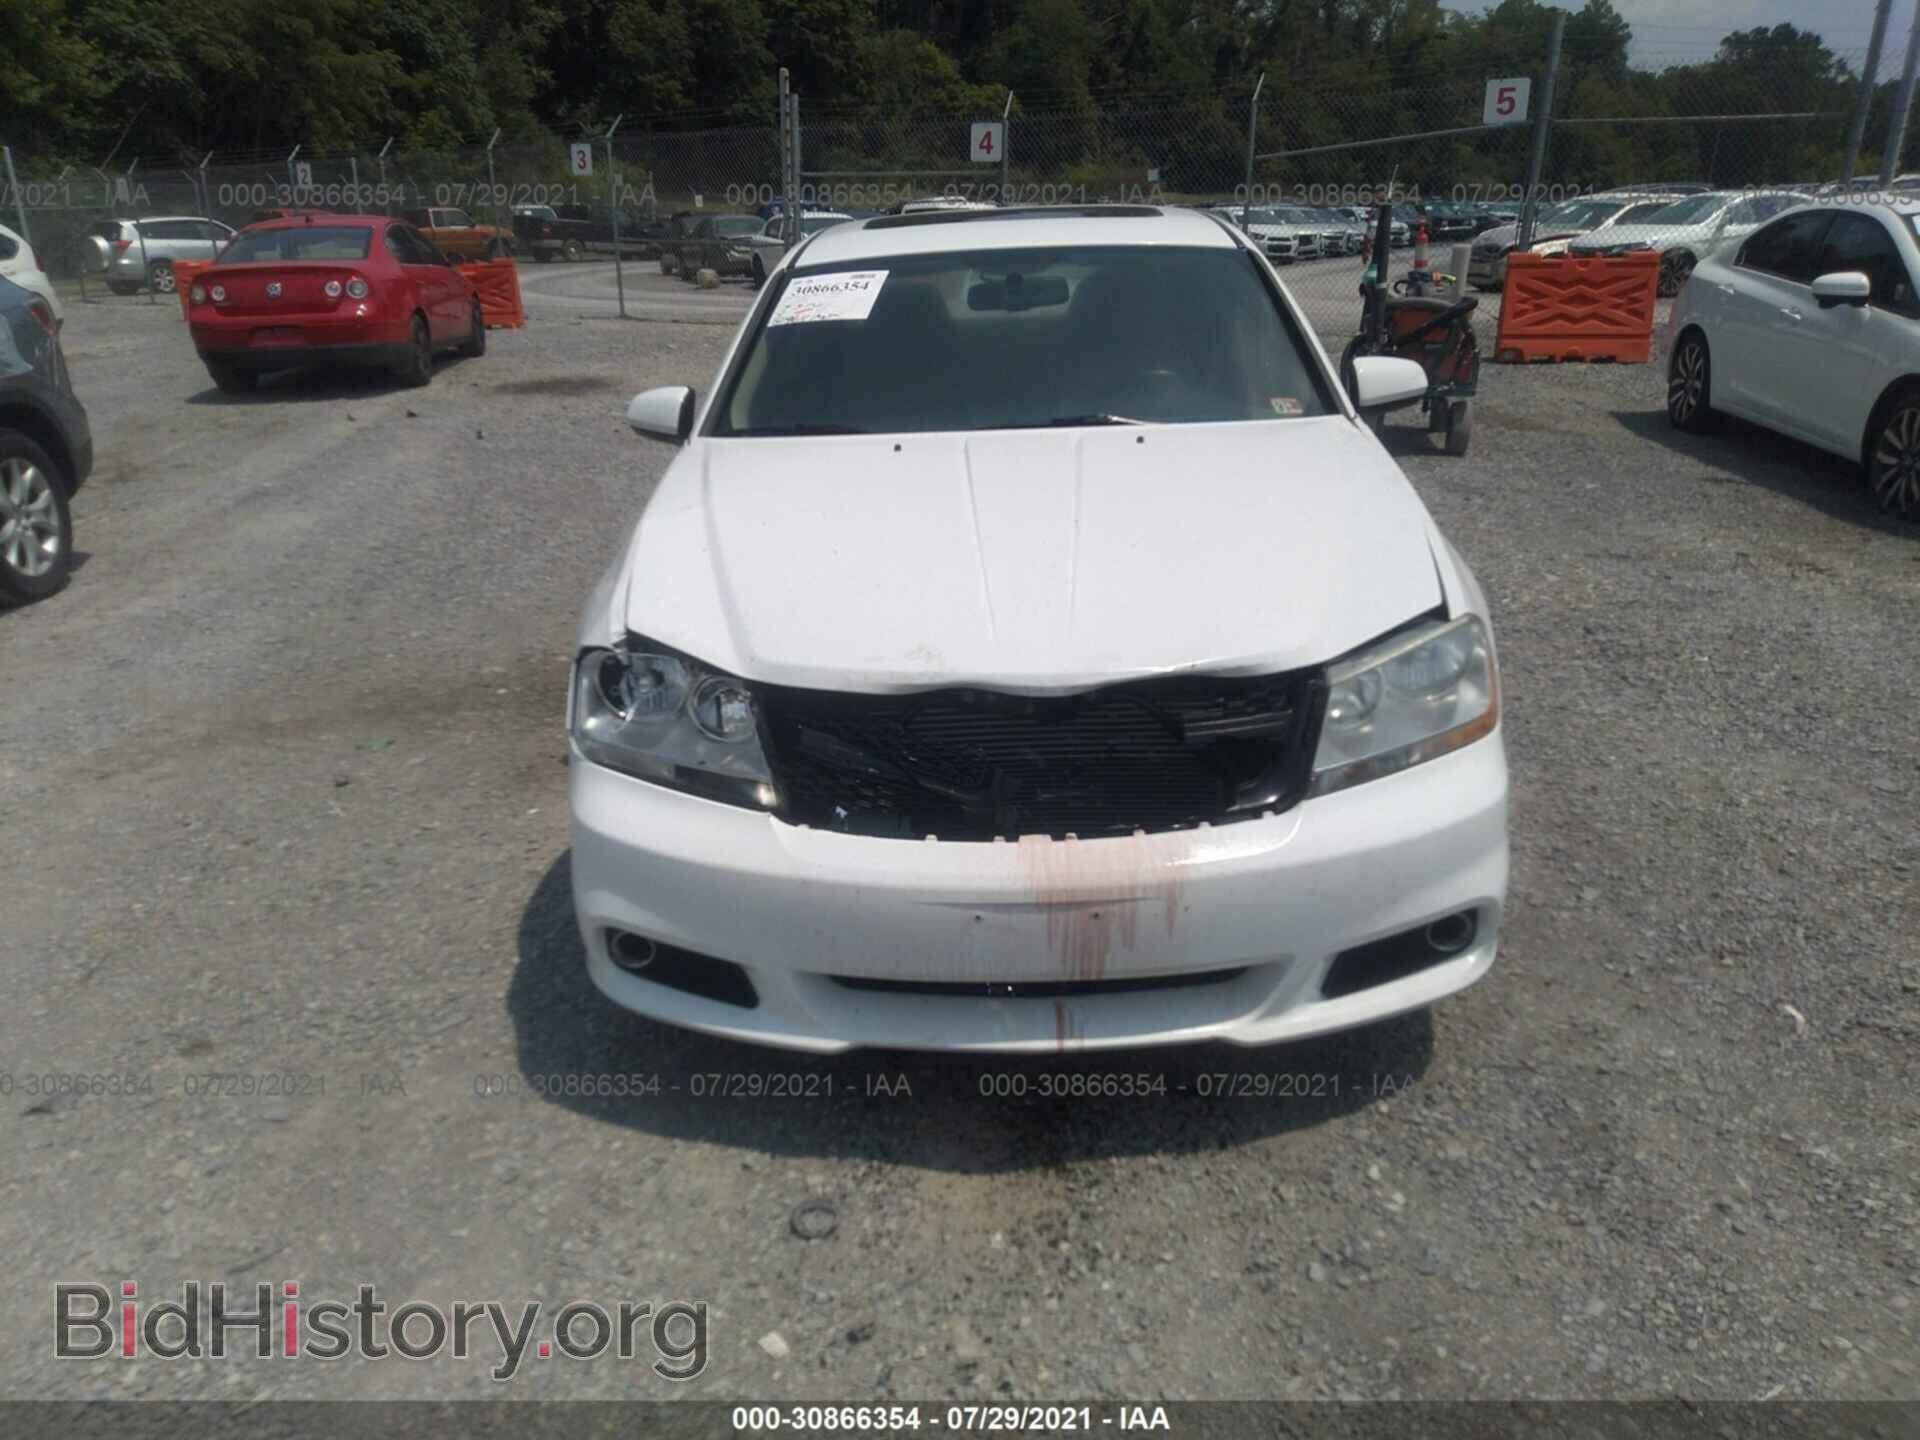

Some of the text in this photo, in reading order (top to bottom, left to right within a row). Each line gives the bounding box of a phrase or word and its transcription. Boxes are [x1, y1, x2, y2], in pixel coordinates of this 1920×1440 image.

[1496, 86, 1516, 116] 5
[979, 130, 994, 155] 4
[576, 149, 587, 170] 3
[792, 280, 871, 297] 30866354
